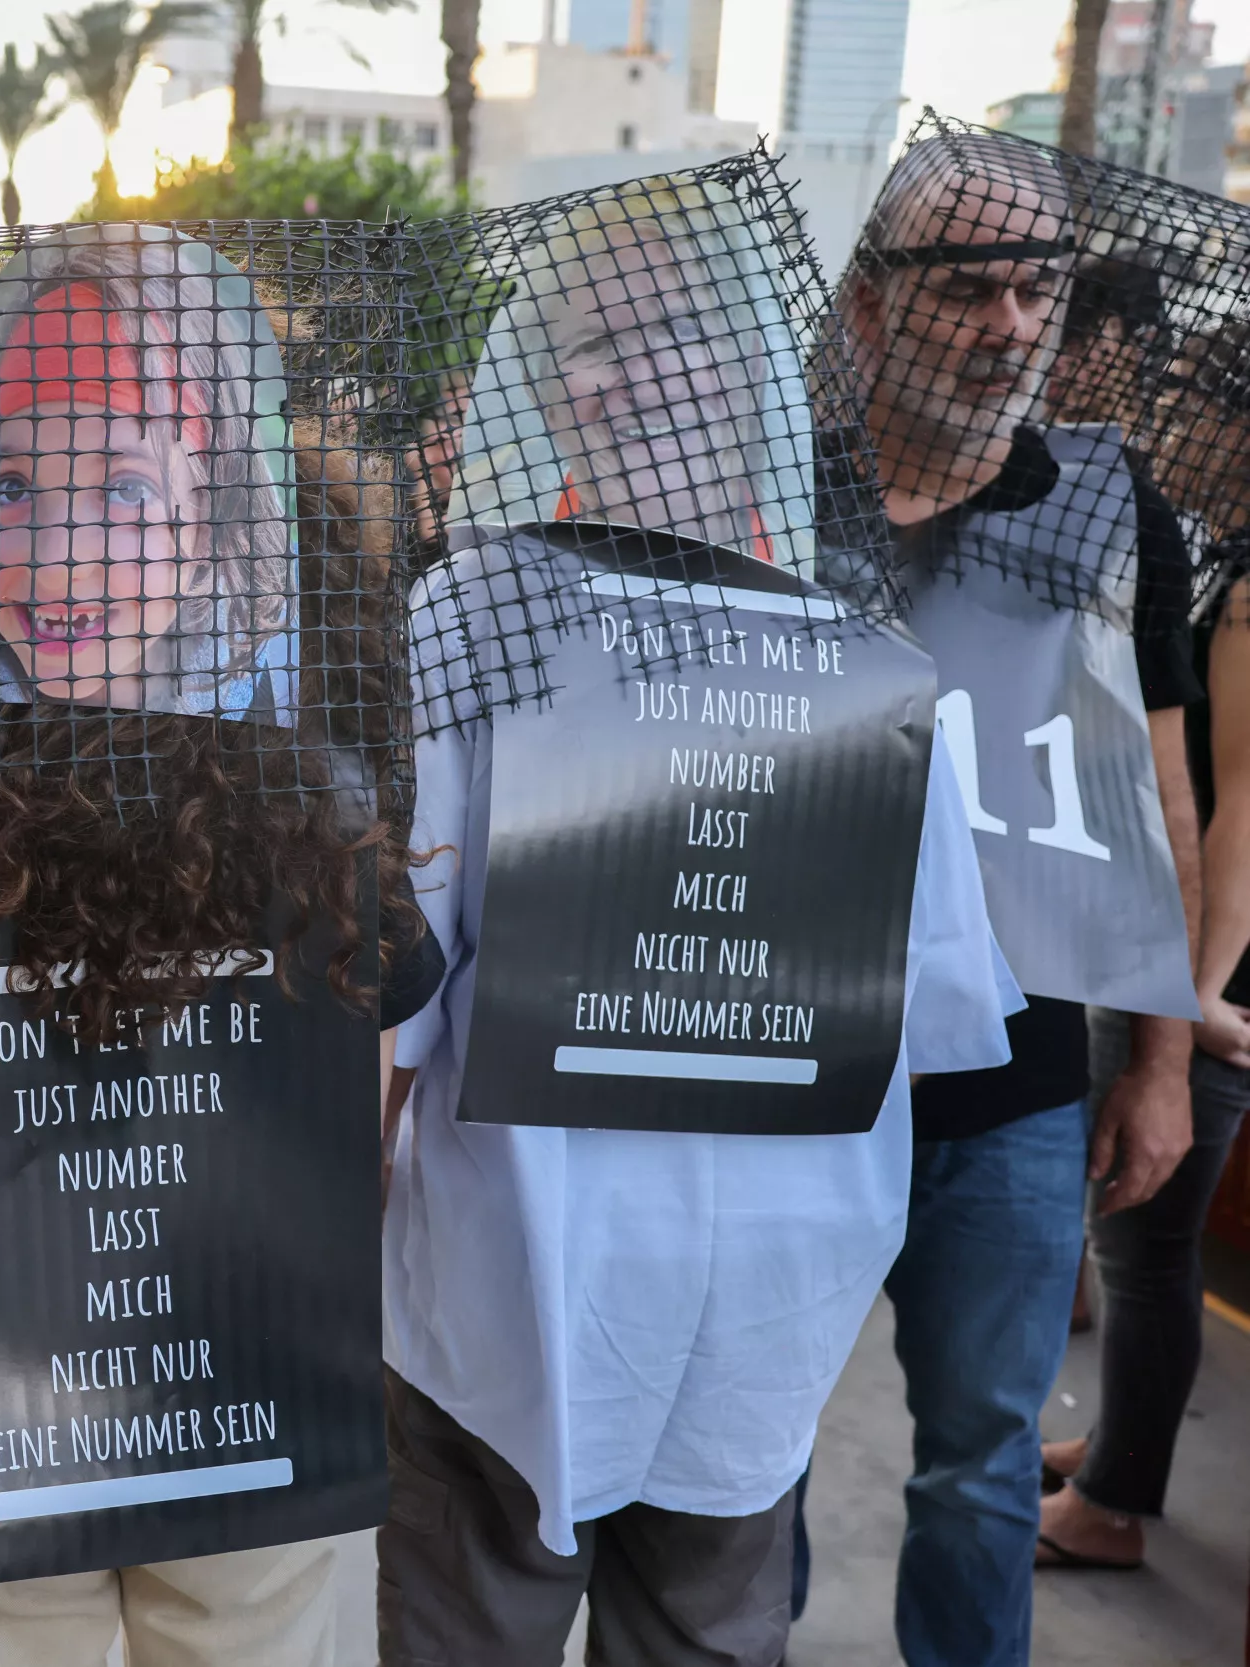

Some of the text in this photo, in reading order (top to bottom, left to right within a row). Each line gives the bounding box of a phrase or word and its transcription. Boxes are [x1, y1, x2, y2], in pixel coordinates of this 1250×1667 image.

[601, 612, 843, 674] DON'T LET ME BE
[636, 682, 810, 733] JUST ANOTHER
[671, 748, 774, 794] NUMBER
[688, 802, 749, 848] LASST
[674, 871, 746, 912] MICH
[635, 932, 768, 978] NICHT NUR
[163, 1005, 212, 1047] ME
[231, 1003, 262, 1043] BE
[576, 991, 813, 1042] EINE NUMMER SEIN
[14, 1073, 223, 1133] JUST ANOTHER
[59, 1144, 187, 1192] NUMBER
[89, 1207, 159, 1252] LASST
[88, 1275, 172, 1322] MICH
[52, 1339, 213, 1393] NICHT NUR
[72, 1409, 205, 1462] NUMMER
[214, 1401, 275, 1447] SEIN
